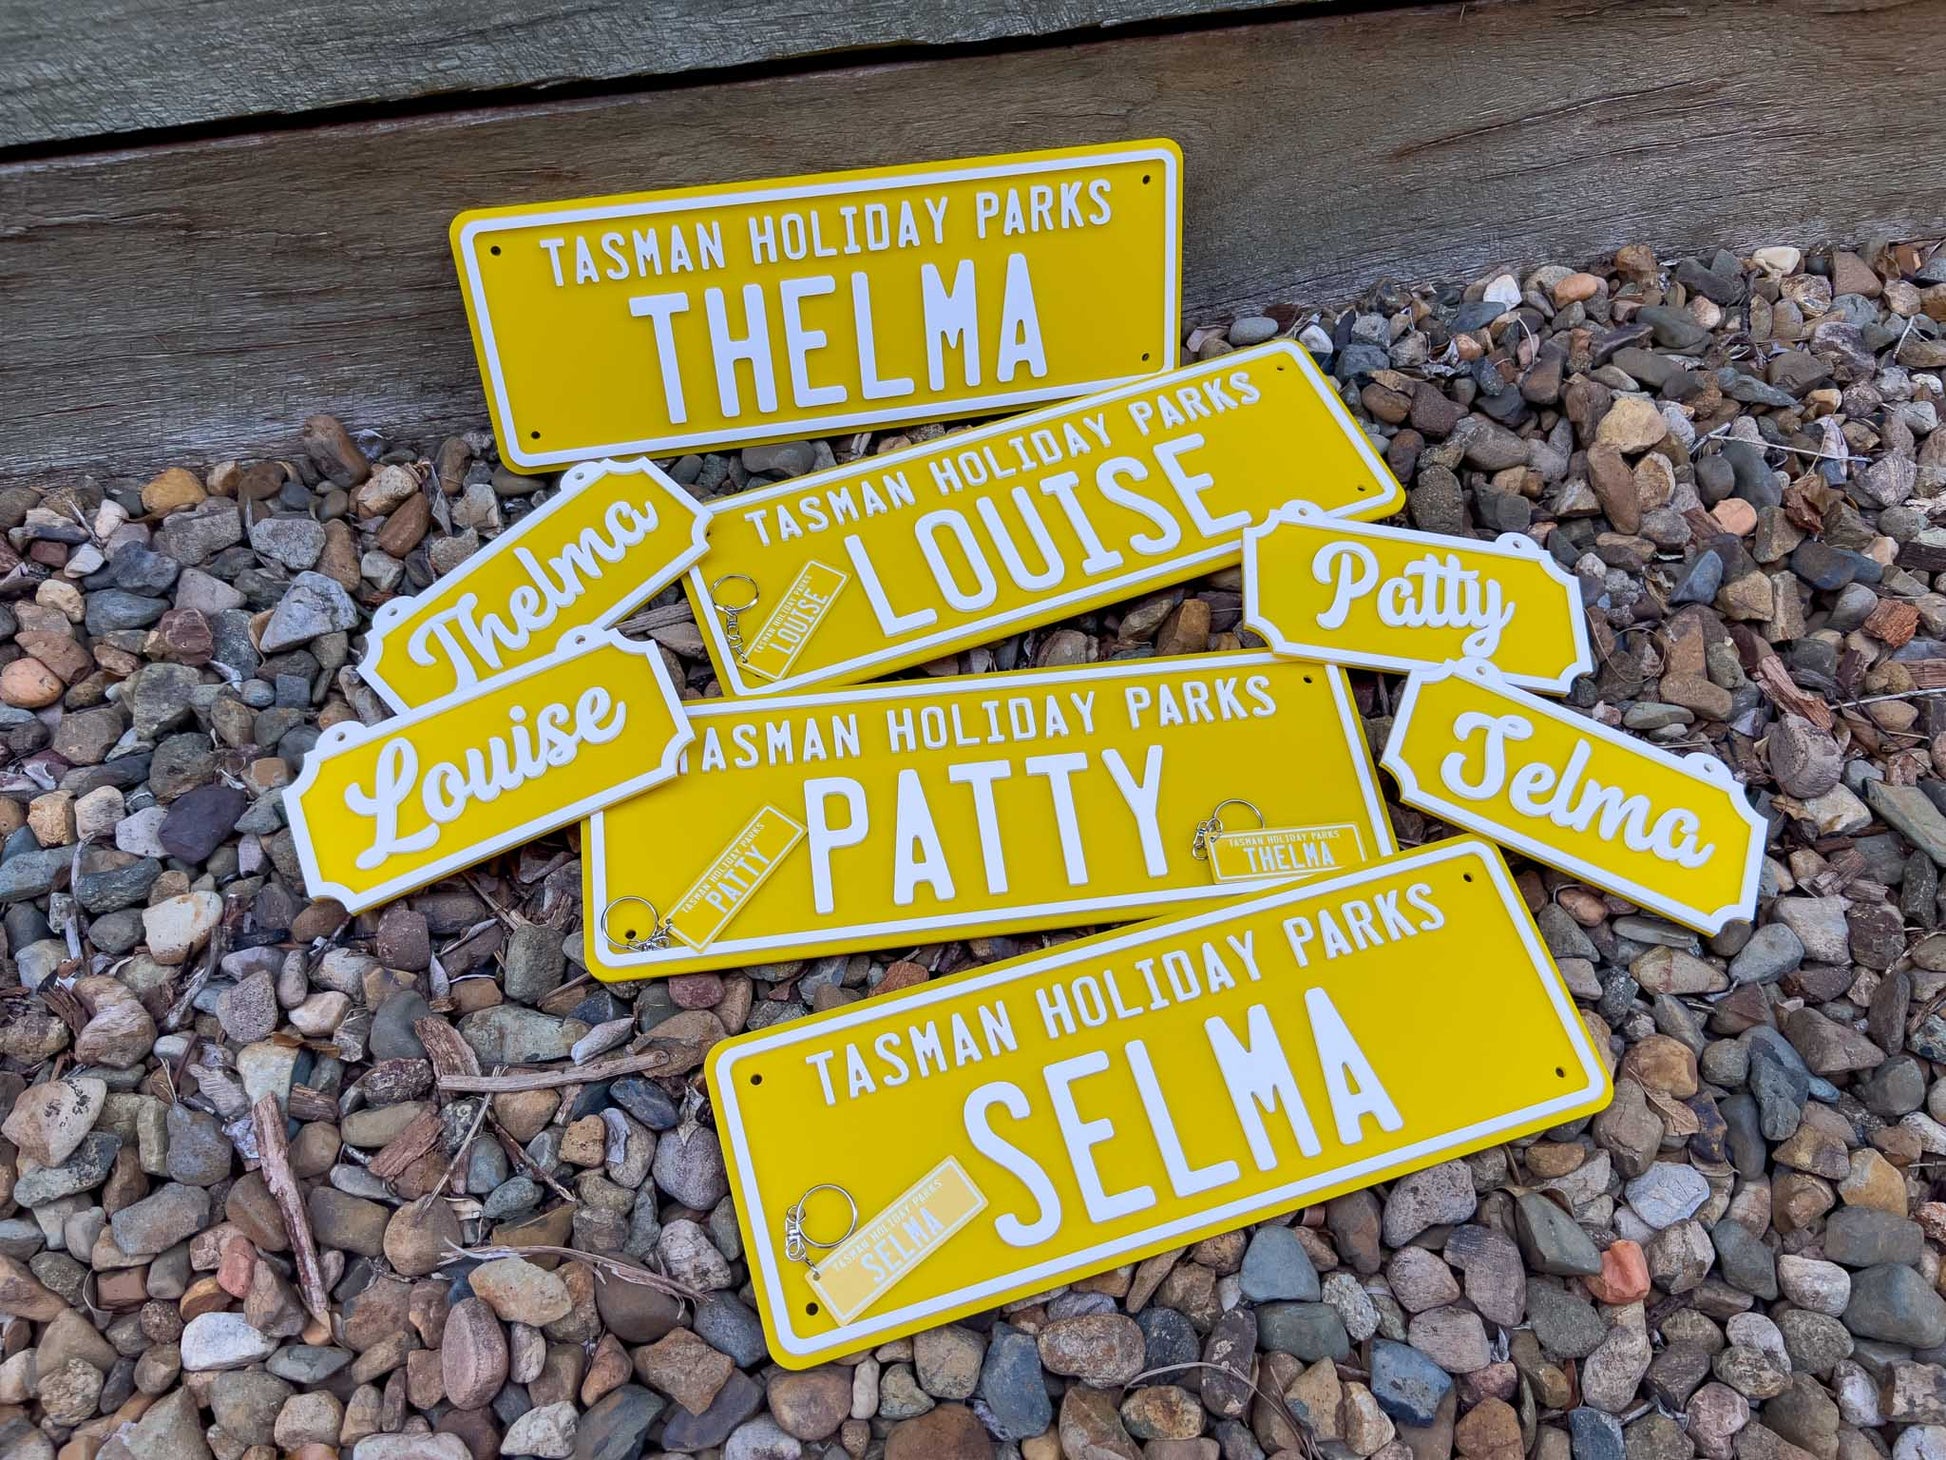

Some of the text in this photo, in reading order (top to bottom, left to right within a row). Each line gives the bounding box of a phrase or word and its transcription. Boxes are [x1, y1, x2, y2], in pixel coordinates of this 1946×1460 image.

[540, 179, 1111, 286] TASMAN HOLIDAY PARKS
[629, 253, 1047, 423] THELMA
[744, 372, 1260, 546] TASMAN HOLIDAY PARKS
[843, 433, 1252, 639] LOUISE
[407, 500, 660, 688] Thelma
[769, 588, 828, 655] LOUISE
[1311, 541, 1515, 658] Patty
[344, 687, 626, 869] Louise
[679, 676, 1276, 774] ASMAN HOLIDAY PARKS
[706, 845, 770, 913] PATTY
[804, 745, 1168, 914] PATTY
[1243, 841, 1335, 873] THELMA
[806, 883, 1445, 1105] TASMAN HOLIDAY PARKS
[964, 984, 1404, 1247] SELMA
[861, 1206, 945, 1284] SELMA
